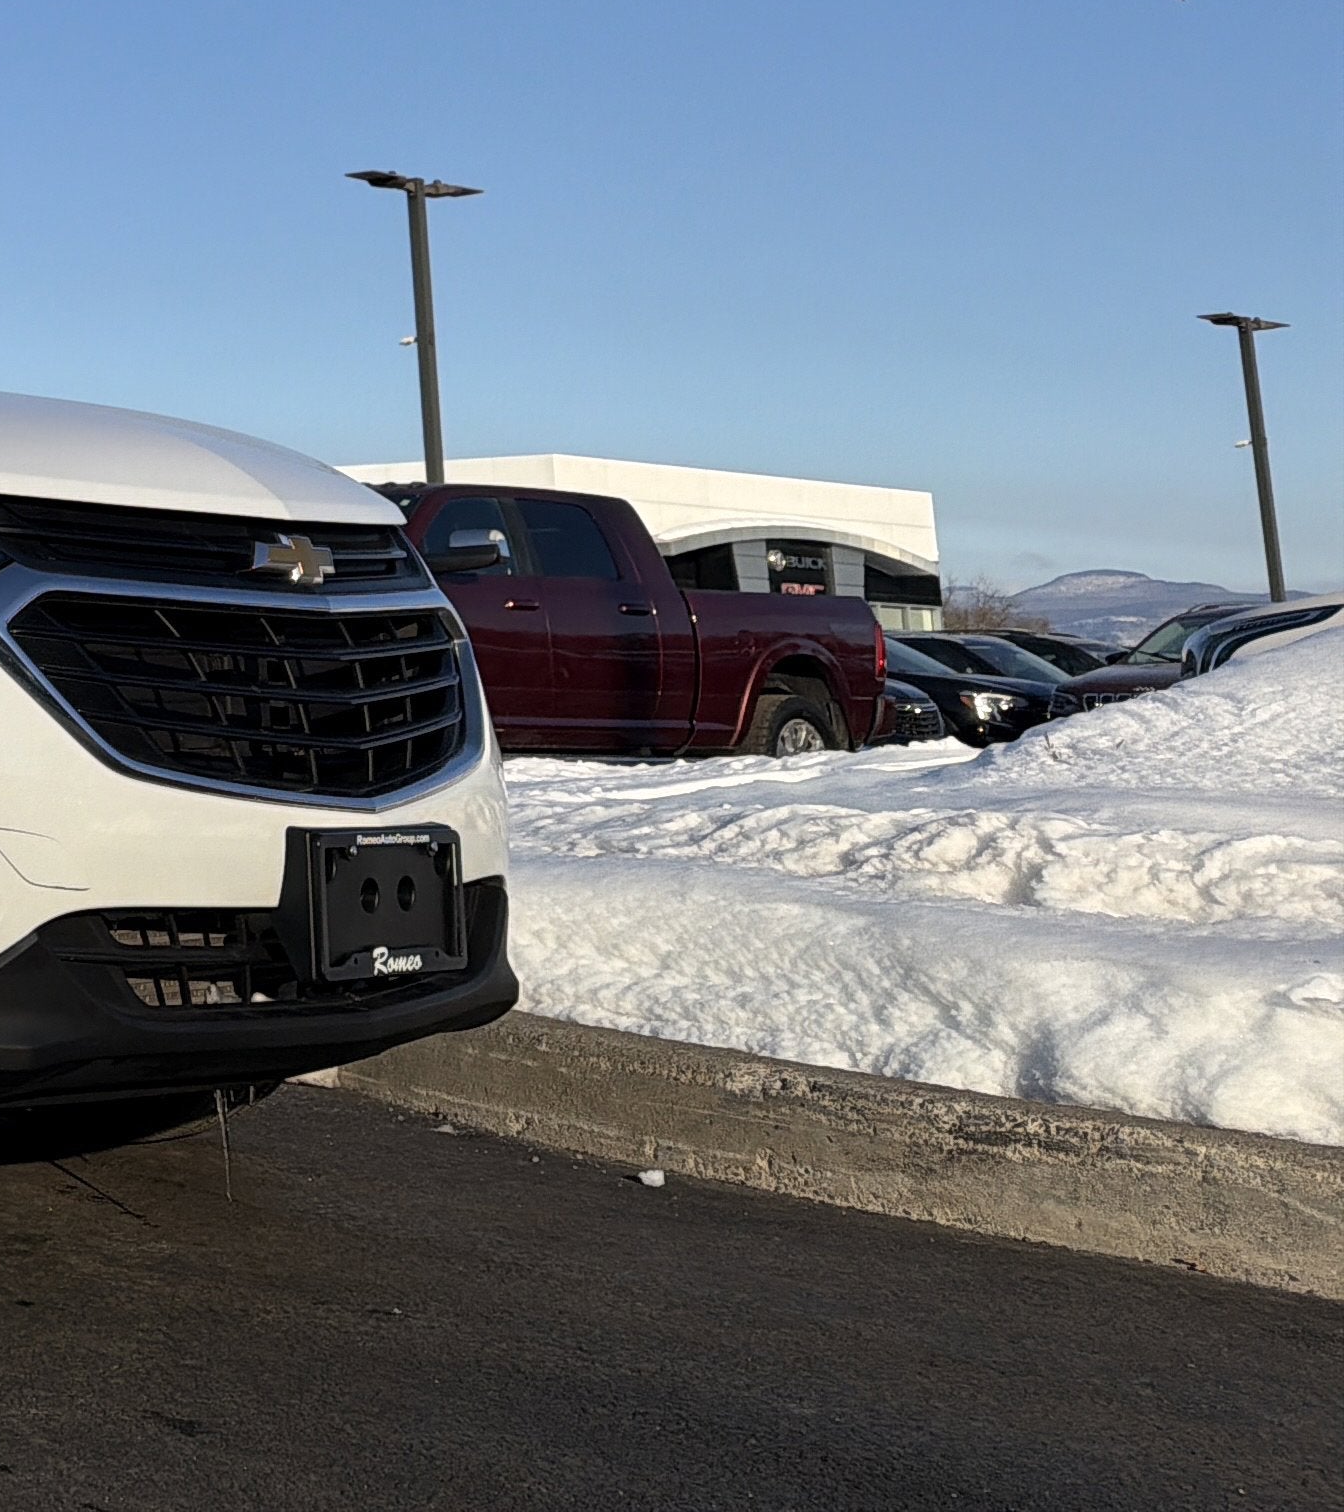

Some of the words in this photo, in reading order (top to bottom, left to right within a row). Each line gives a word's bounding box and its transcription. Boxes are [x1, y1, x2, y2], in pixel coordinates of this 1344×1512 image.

[786, 555, 827, 570] BUICK
[356, 833, 431, 846] RomeoAutoGroup.com
[372, 946, 423, 977] Romeo
